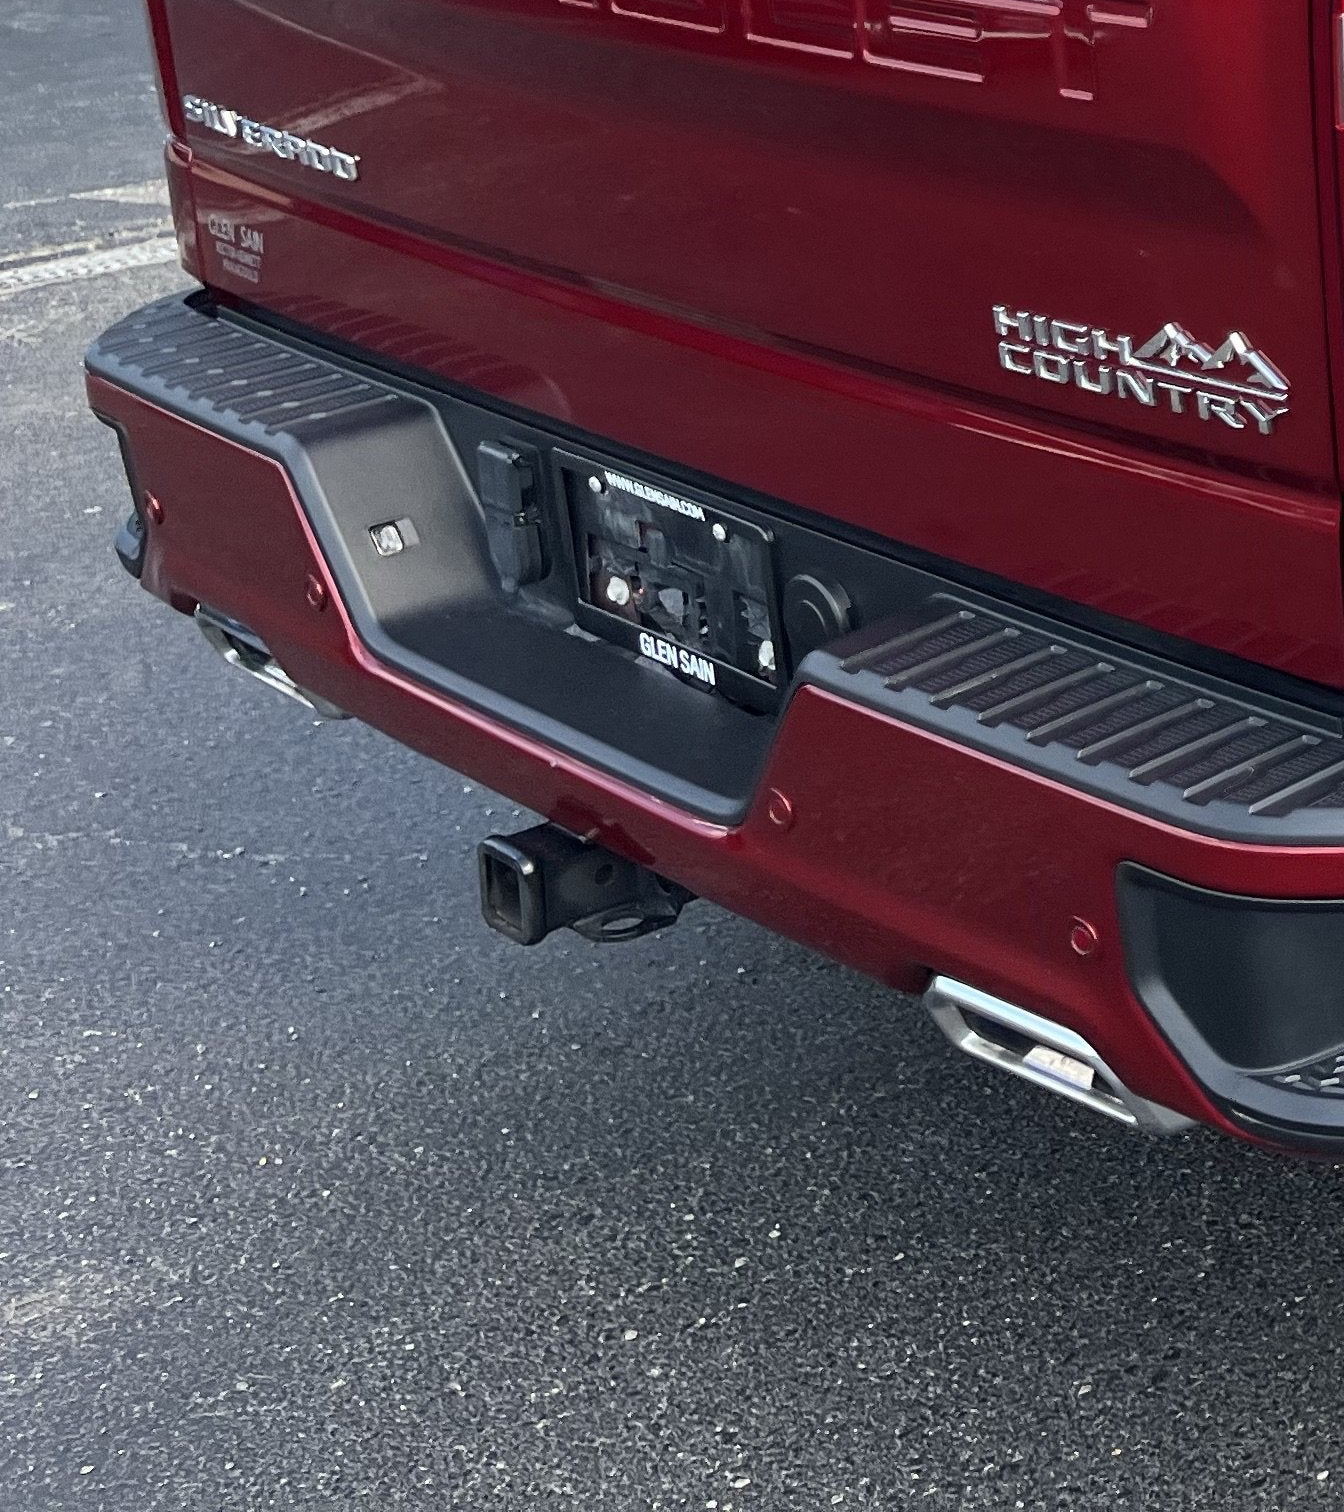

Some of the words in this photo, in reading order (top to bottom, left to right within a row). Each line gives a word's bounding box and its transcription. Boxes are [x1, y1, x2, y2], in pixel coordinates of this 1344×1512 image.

[182, 94, 361, 181] SILVERADO
[992, 304, 1134, 366] HIGH
[998, 340, 1290, 435] COUNTRY
[639, 632, 679, 669] GLEN
[679, 649, 716, 686] SAIN
